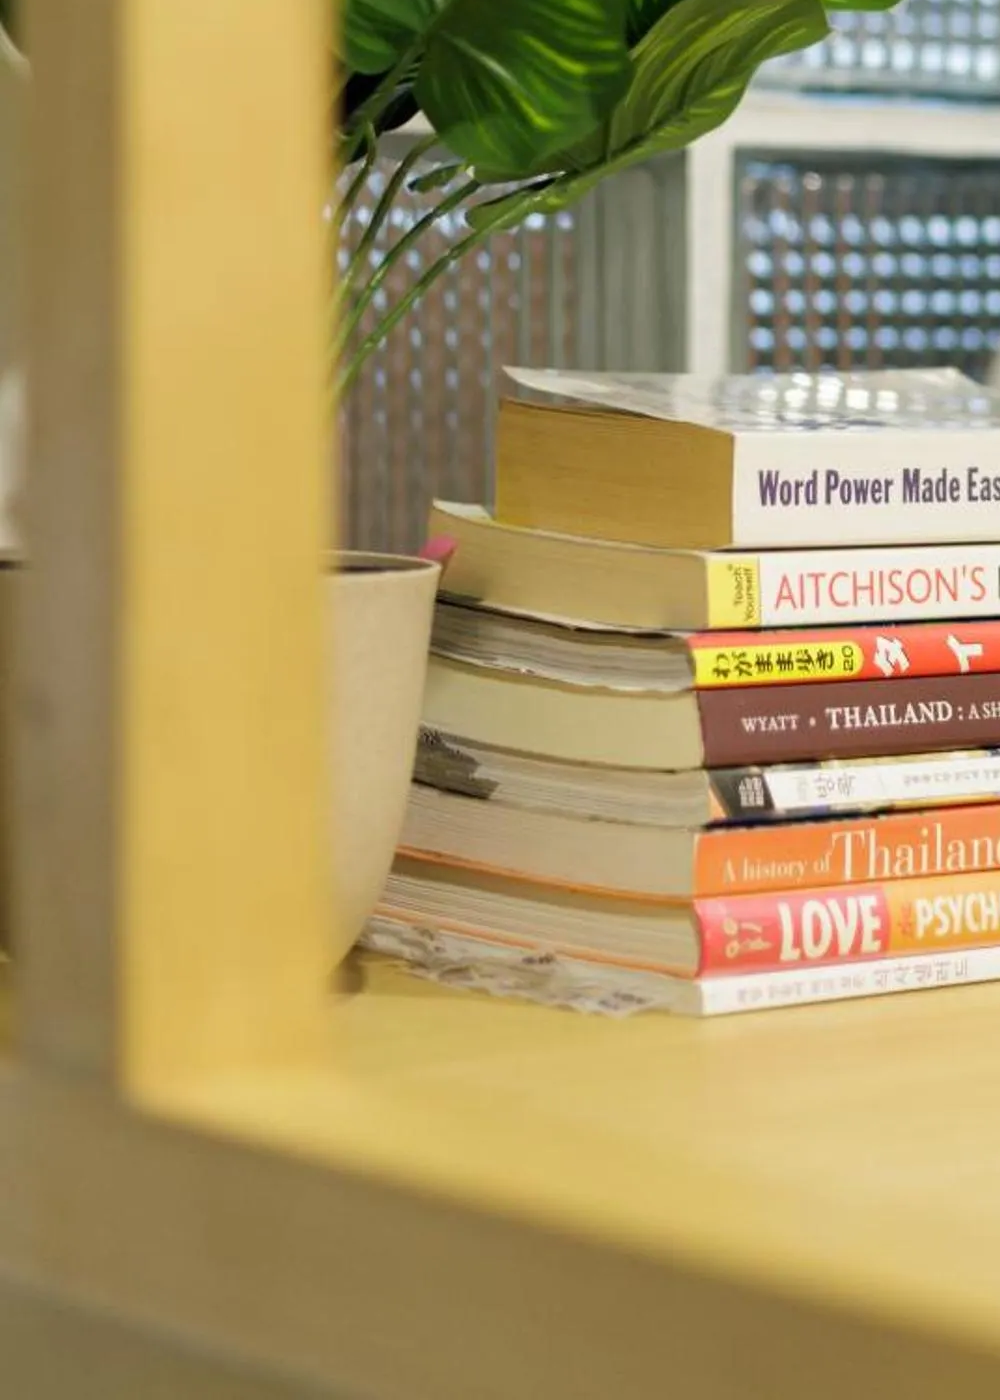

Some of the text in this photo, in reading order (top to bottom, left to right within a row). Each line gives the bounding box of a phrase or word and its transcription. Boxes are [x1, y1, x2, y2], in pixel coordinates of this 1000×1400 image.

[758, 469, 818, 506] Word
[824, 469, 894, 505] Power
[902, 467, 961, 504] Made
[733, 567, 745, 605] Teach
[743, 567, 756, 622] Yourself
[774, 565, 987, 609] AITCHISON'S
[741, 714, 799, 733] WYATT
[968, 703, 981, 720] A
[723, 859, 736, 884] A
[743, 855, 808, 883] history
[813, 850, 834, 874] of
[777, 895, 882, 963] LOVE
